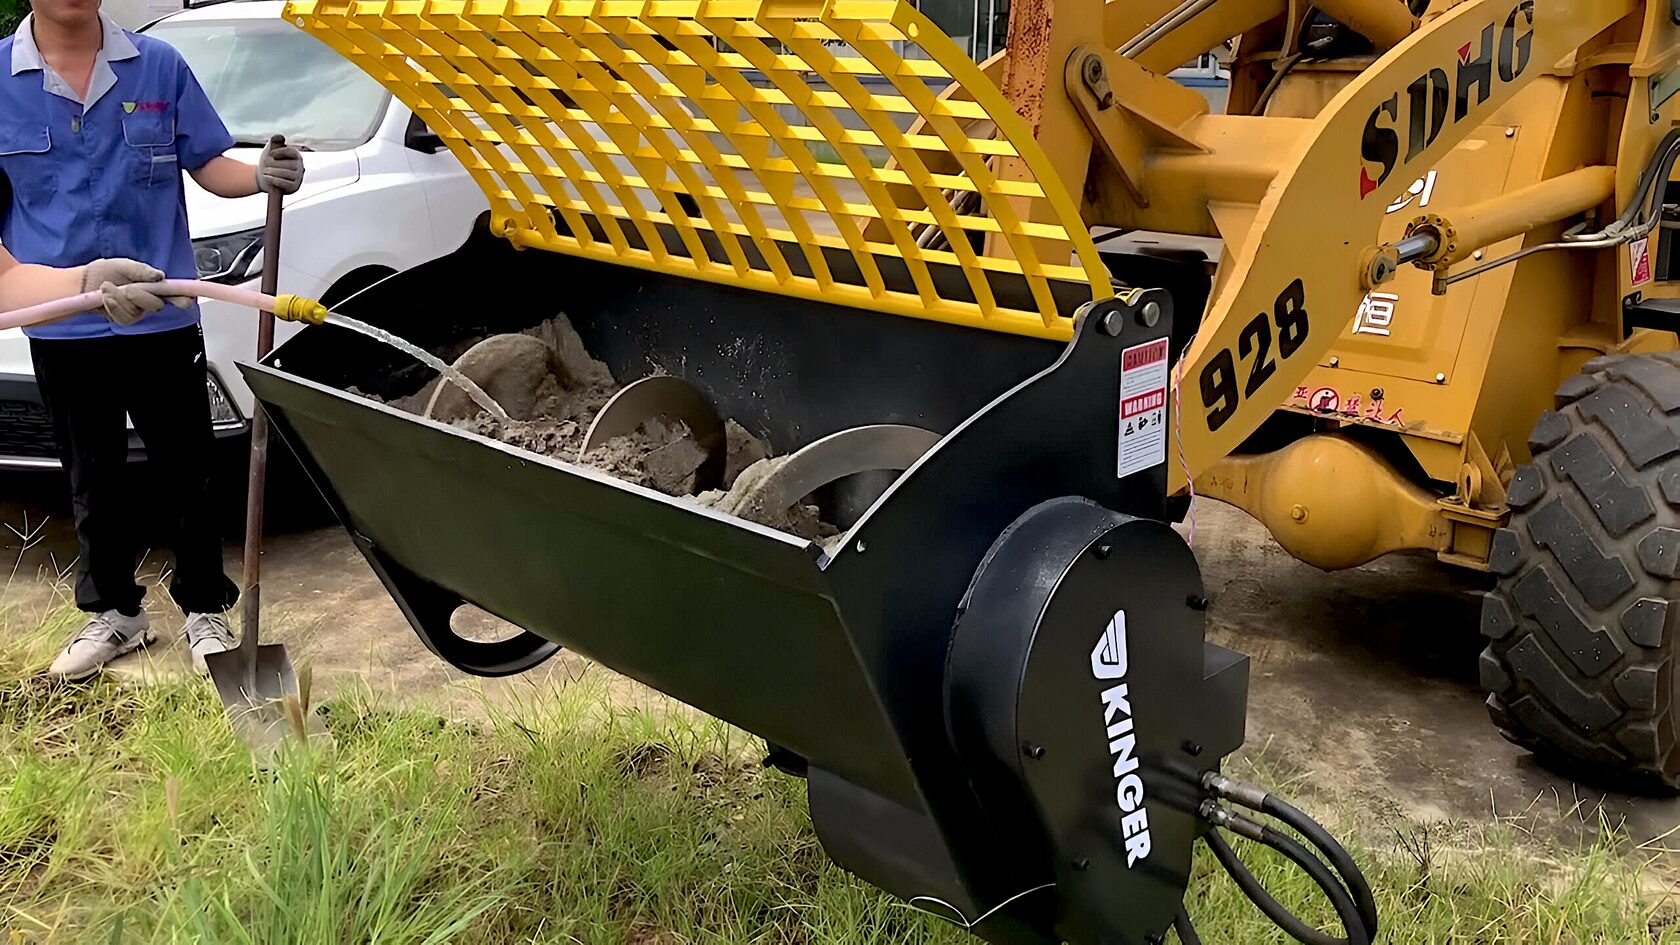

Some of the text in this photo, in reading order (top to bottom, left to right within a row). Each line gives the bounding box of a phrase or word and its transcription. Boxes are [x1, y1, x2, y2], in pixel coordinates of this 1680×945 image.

[1360, 0, 1534, 200] SDHG
[1124, 391, 1163, 416] WARNING
[1199, 277, 1310, 432] 928
[1101, 683, 1152, 869] KINGER
